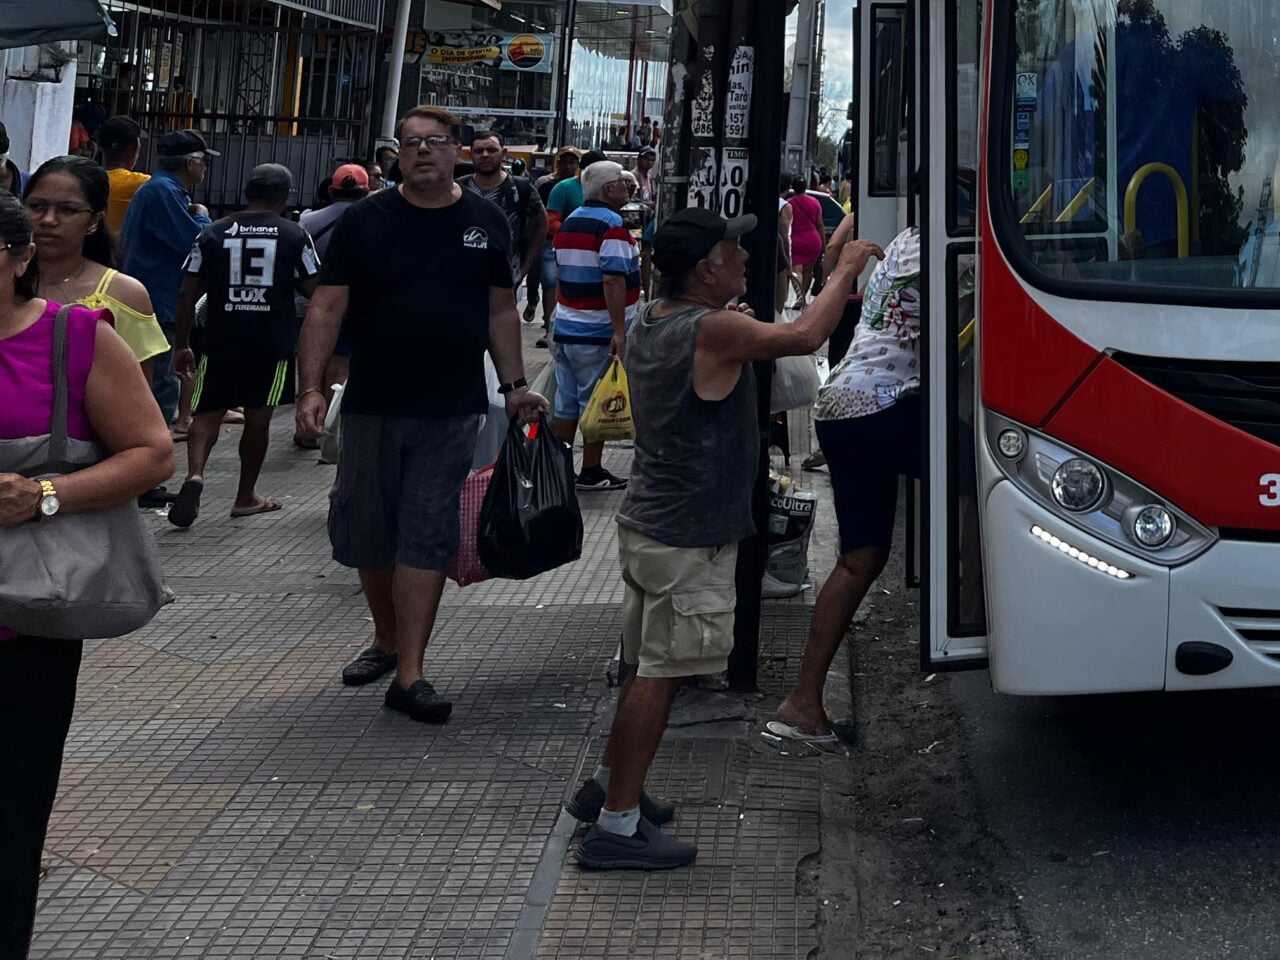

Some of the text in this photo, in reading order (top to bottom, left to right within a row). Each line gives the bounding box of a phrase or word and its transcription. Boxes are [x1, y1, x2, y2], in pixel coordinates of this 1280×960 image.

[1017, 74, 1036, 86] OK
[240, 225, 279, 233] brisanet
[222, 238, 277, 287] 13
